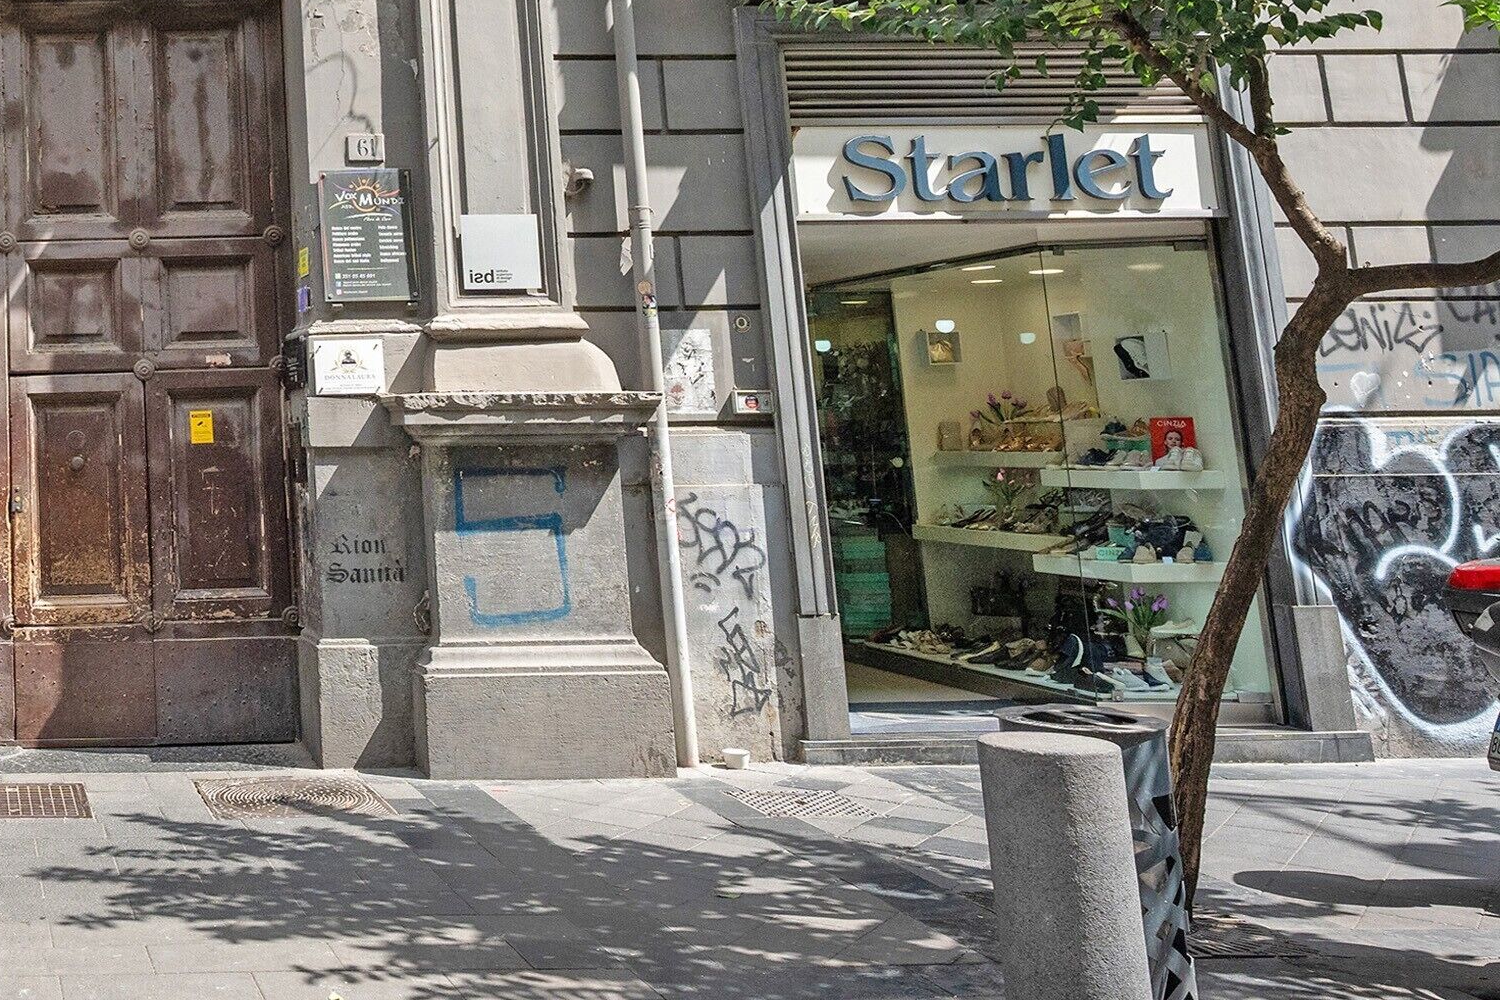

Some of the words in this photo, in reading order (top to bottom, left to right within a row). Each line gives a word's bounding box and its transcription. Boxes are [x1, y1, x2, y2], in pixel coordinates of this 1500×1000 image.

[842, 133, 1174, 203] Starlet
[1156, 420, 1187, 428] CINZIA
[326, 559, 405, 584] Sanità
